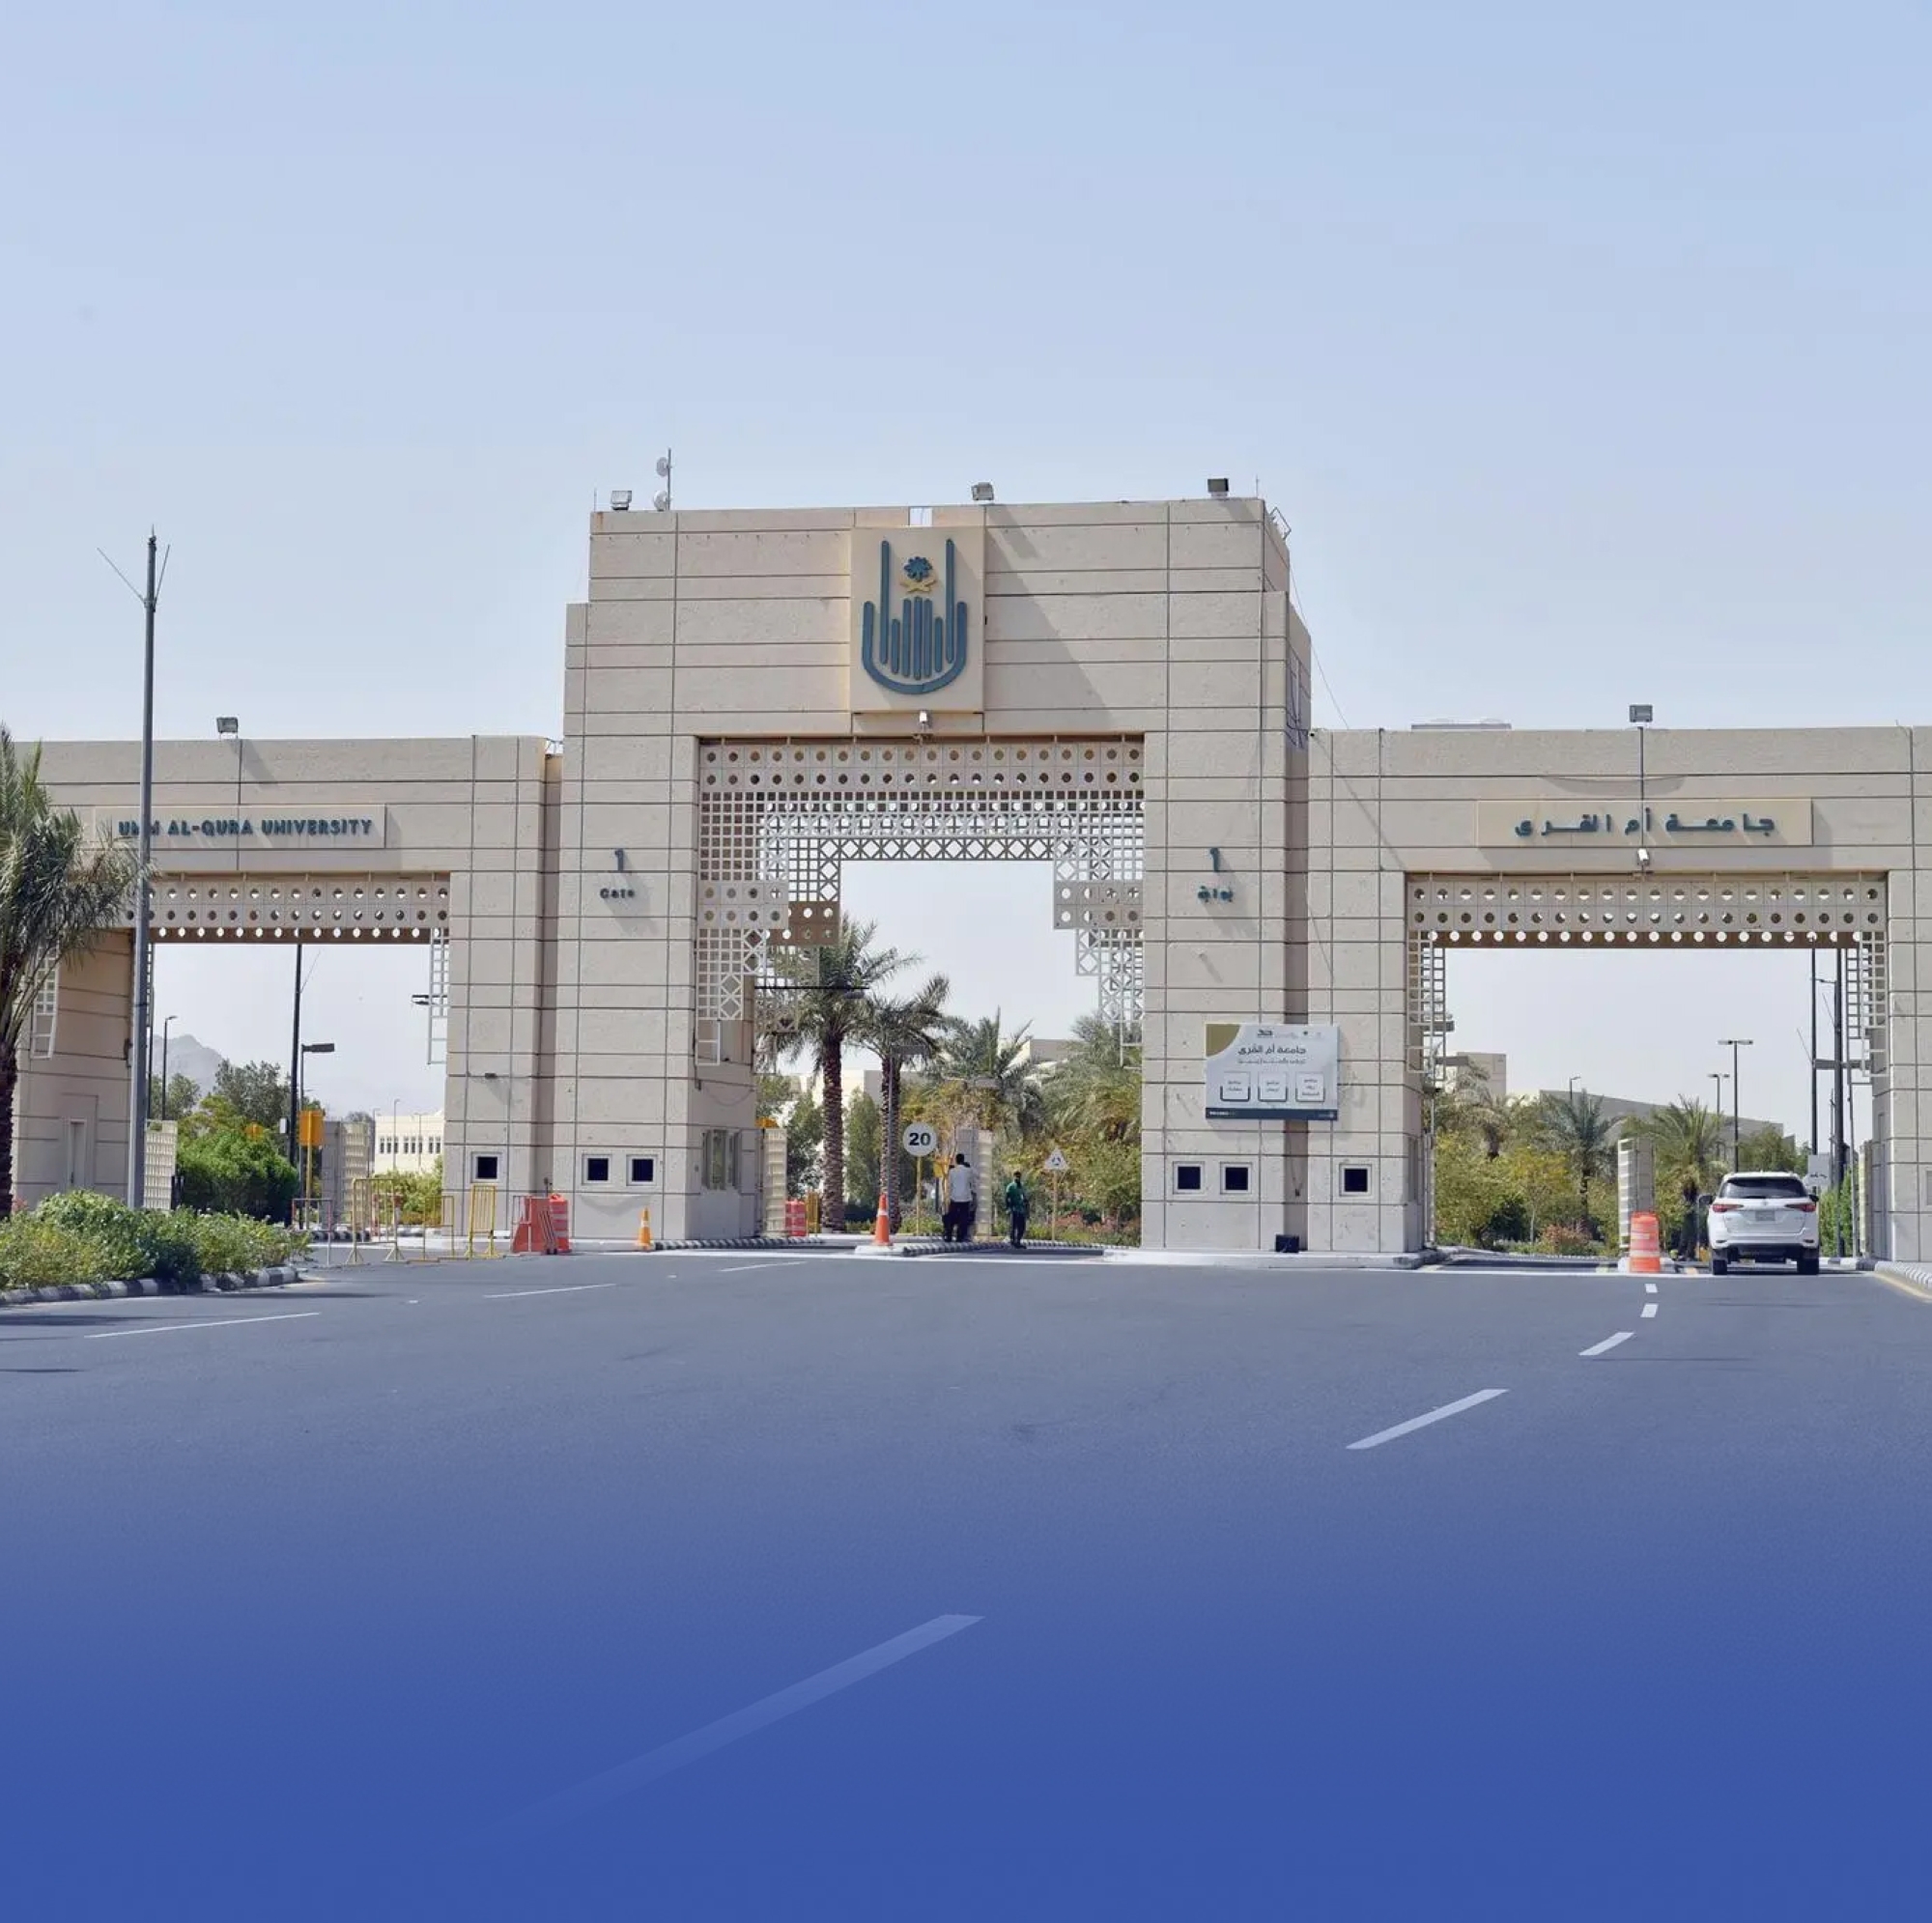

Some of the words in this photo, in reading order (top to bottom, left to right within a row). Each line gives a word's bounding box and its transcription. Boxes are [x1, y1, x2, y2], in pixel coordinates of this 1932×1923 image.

[167, 819, 253, 837] AL-QURA
[261, 819, 373, 836] UNIVERSITY
[1514, 813, 1612, 837] القرى
[1624, 806, 1652, 835] أم
[1664, 812, 1776, 837] جامعة
[908, 1132, 931, 1146] 20
